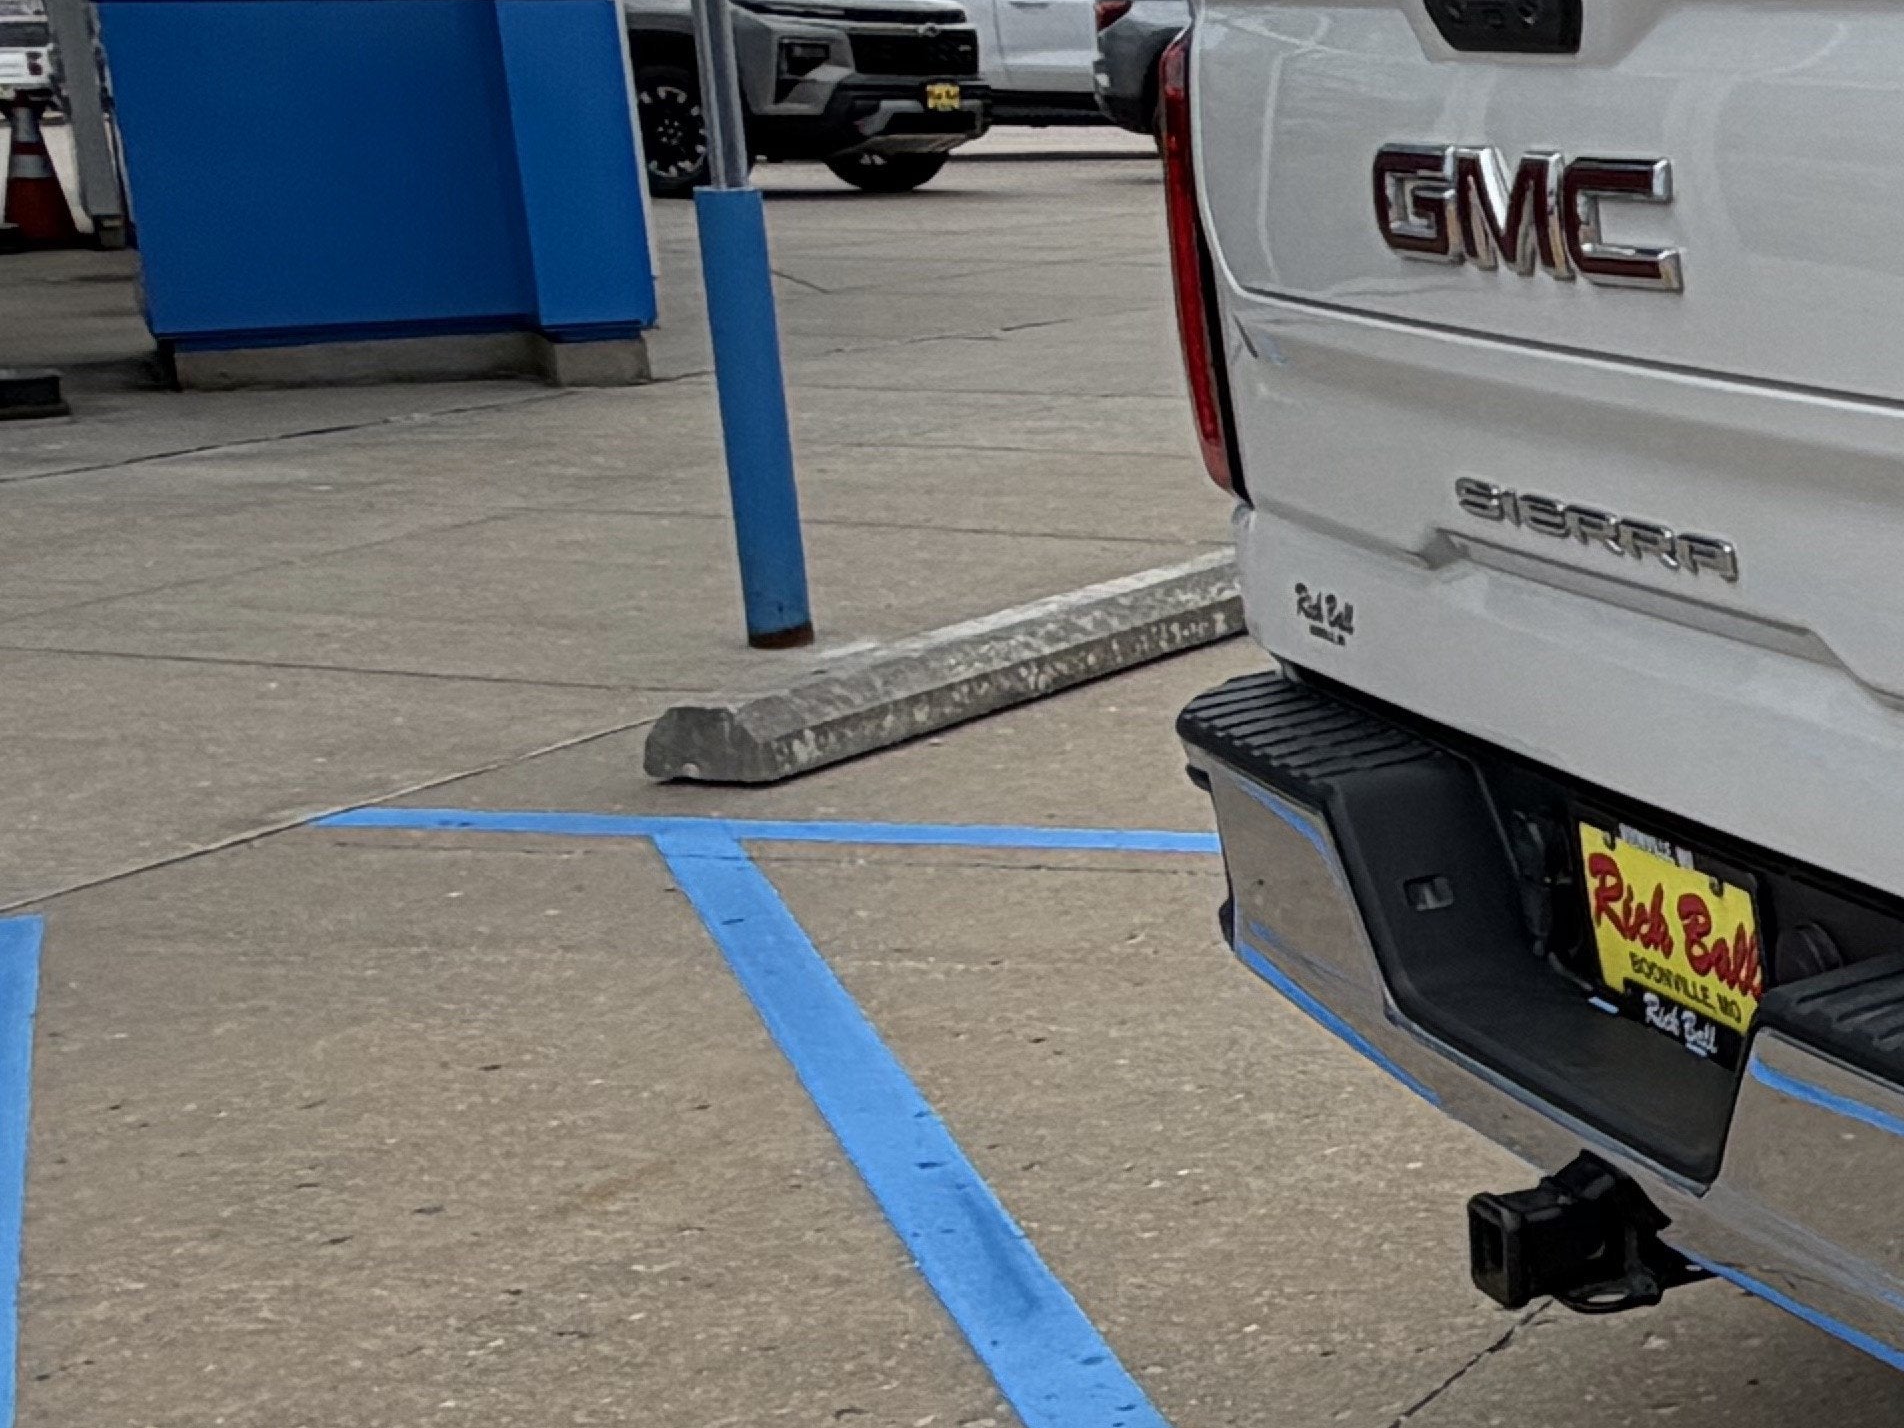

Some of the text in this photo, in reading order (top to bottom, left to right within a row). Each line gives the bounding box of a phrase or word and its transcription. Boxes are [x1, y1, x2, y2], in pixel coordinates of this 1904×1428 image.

[1373, 142, 1685, 293] GMC
[1454, 476, 1739, 583] SIERRA
[1588, 852, 1764, 1002] Rick Ball
[1643, 992, 1718, 1055] Rick Ball
[1717, 993, 1742, 1024] MO
